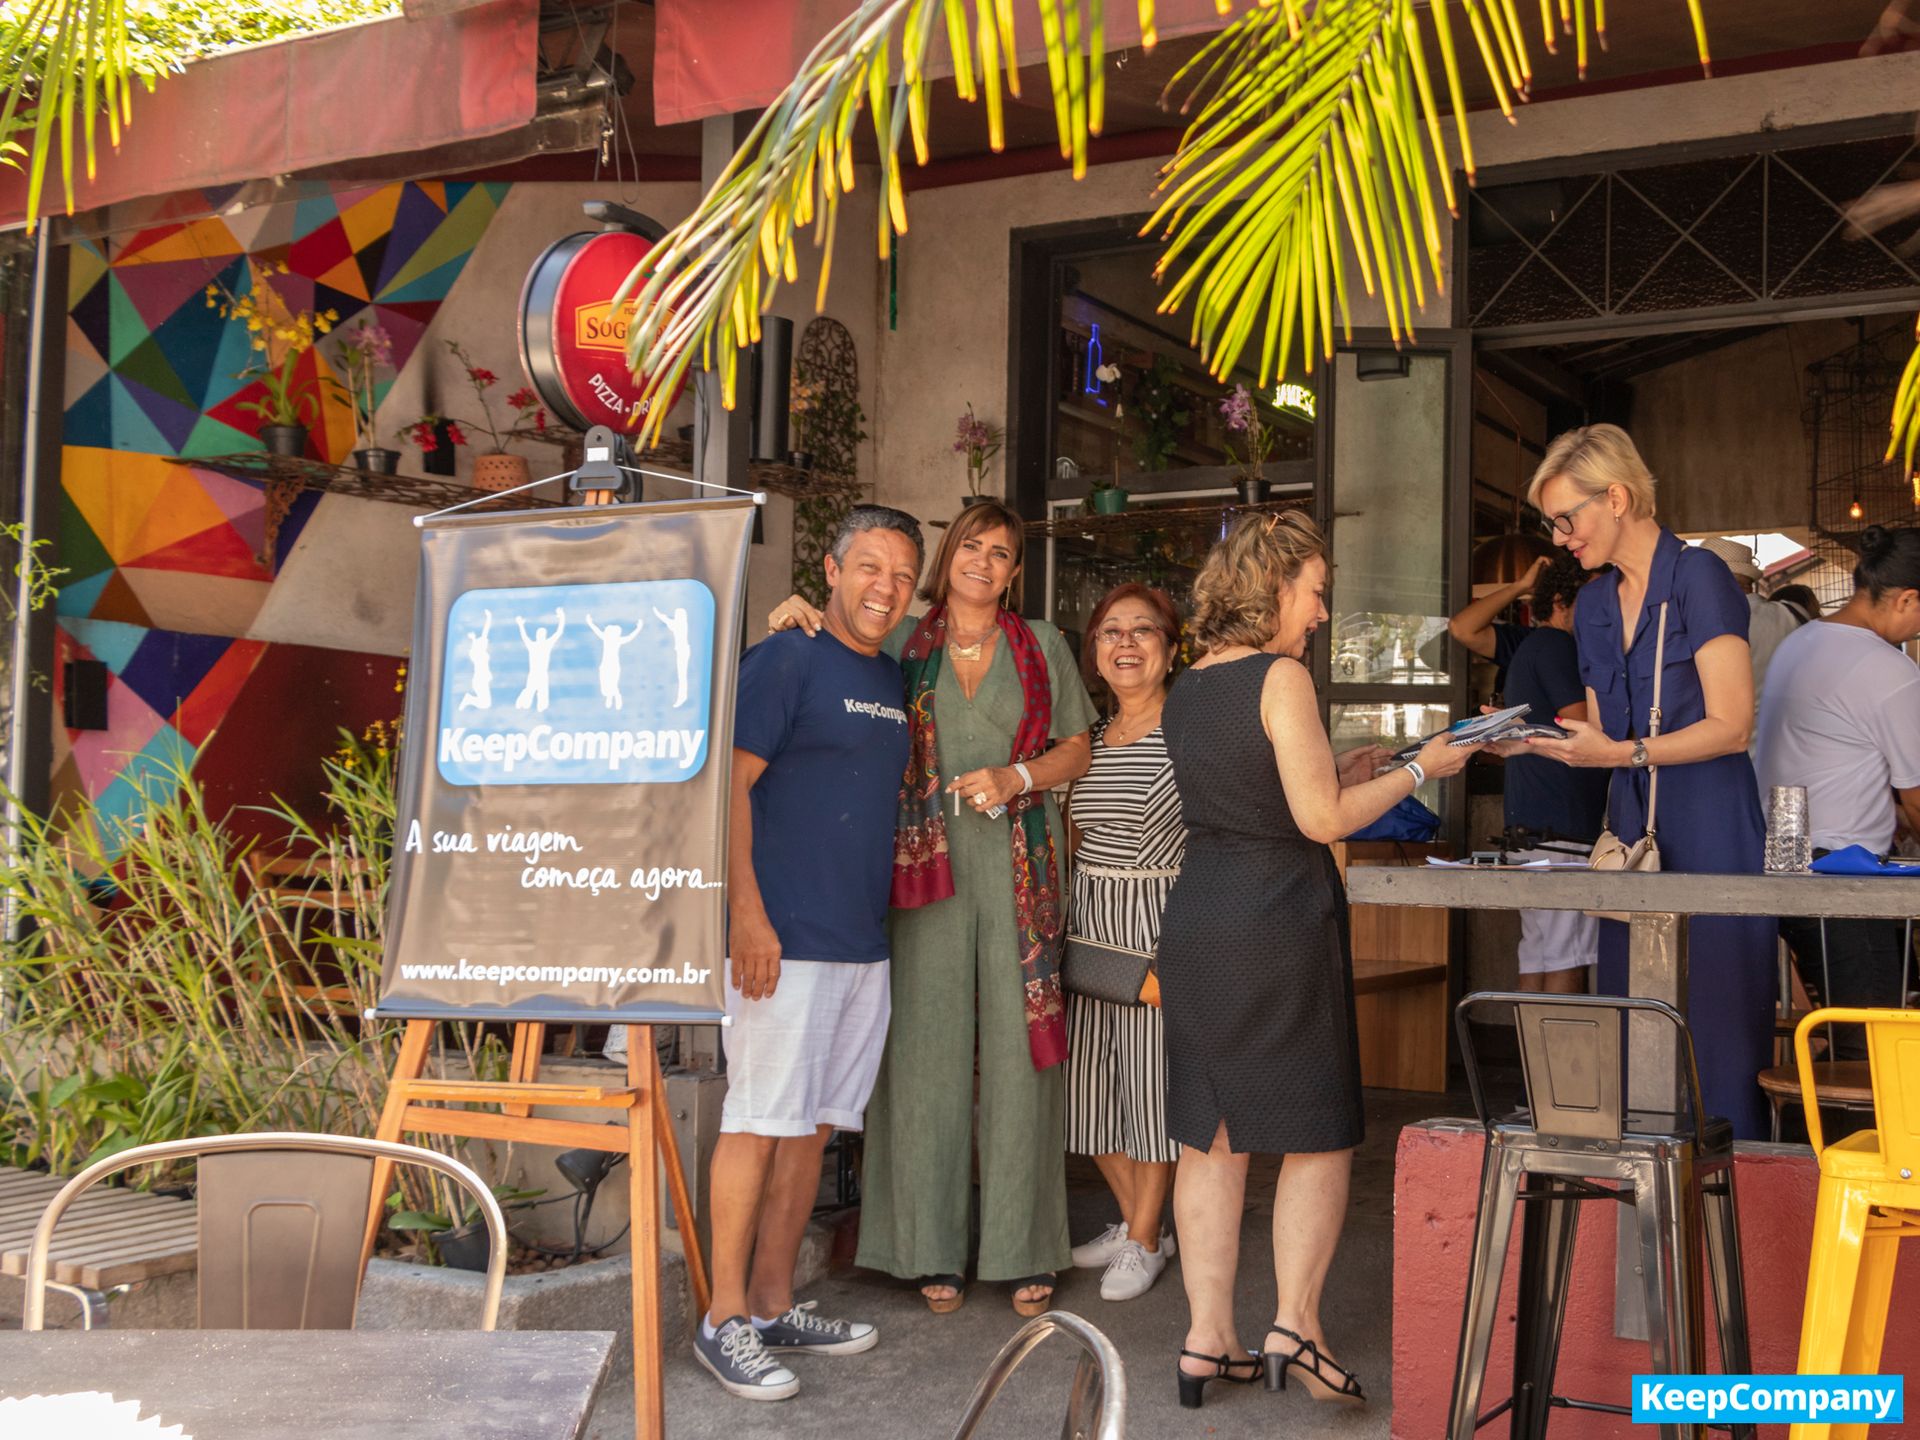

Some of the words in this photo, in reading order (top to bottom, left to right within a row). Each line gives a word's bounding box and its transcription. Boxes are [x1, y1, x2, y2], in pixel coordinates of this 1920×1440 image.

[588, 373, 623, 414] PIZZA
[440, 725, 705, 773] KeepCompany
[405, 819, 423, 854] A
[432, 829, 478, 853] sua
[486, 824, 583, 864] viagem
[521, 866, 621, 896] começa
[401, 959, 711, 988] www.keepcompany.com.br
